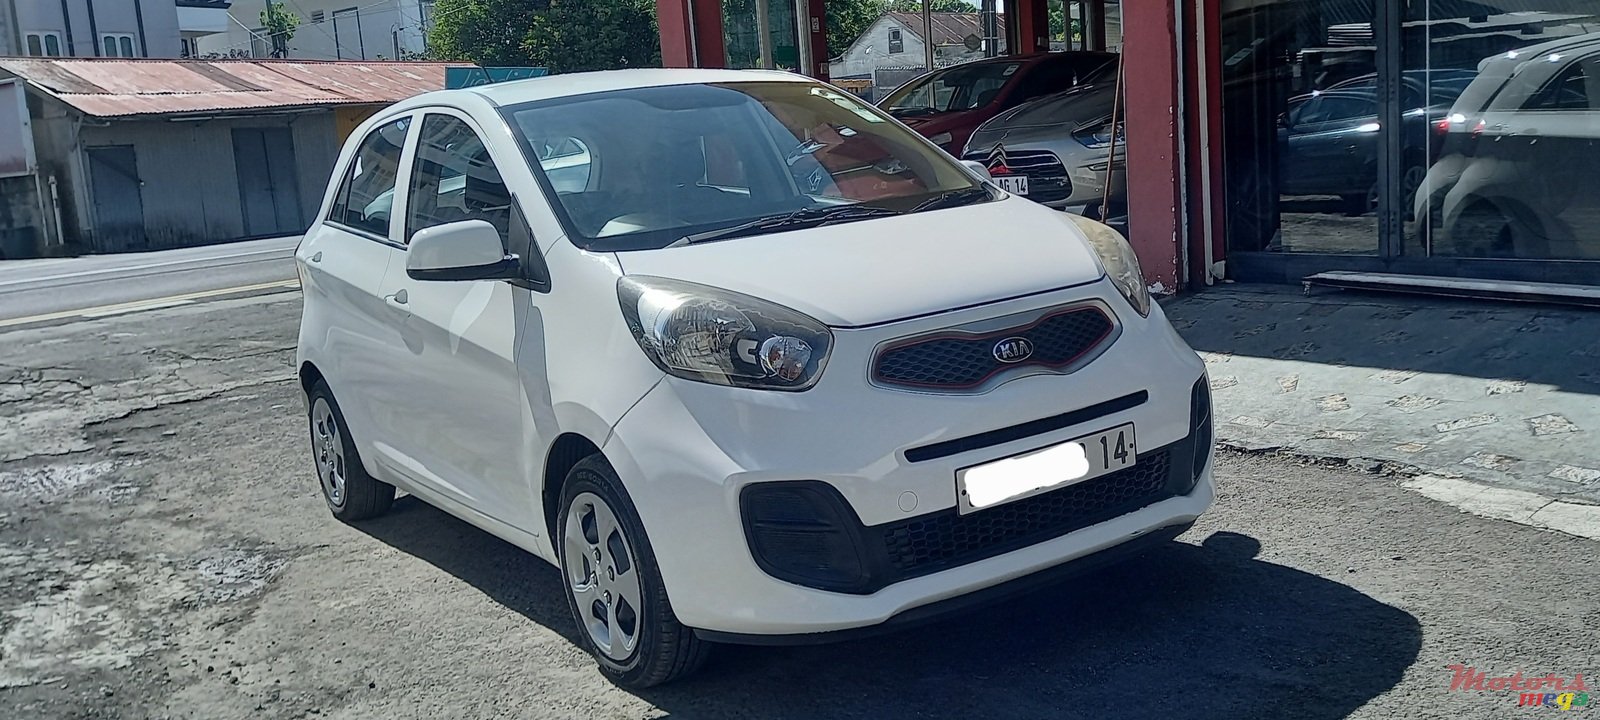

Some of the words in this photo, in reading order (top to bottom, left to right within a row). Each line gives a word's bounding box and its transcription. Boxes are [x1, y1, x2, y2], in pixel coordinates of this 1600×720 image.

[1015, 178, 1027, 193] 14
[1000, 340, 1030, 359] KIA
[1100, 430, 1128, 469] 14
